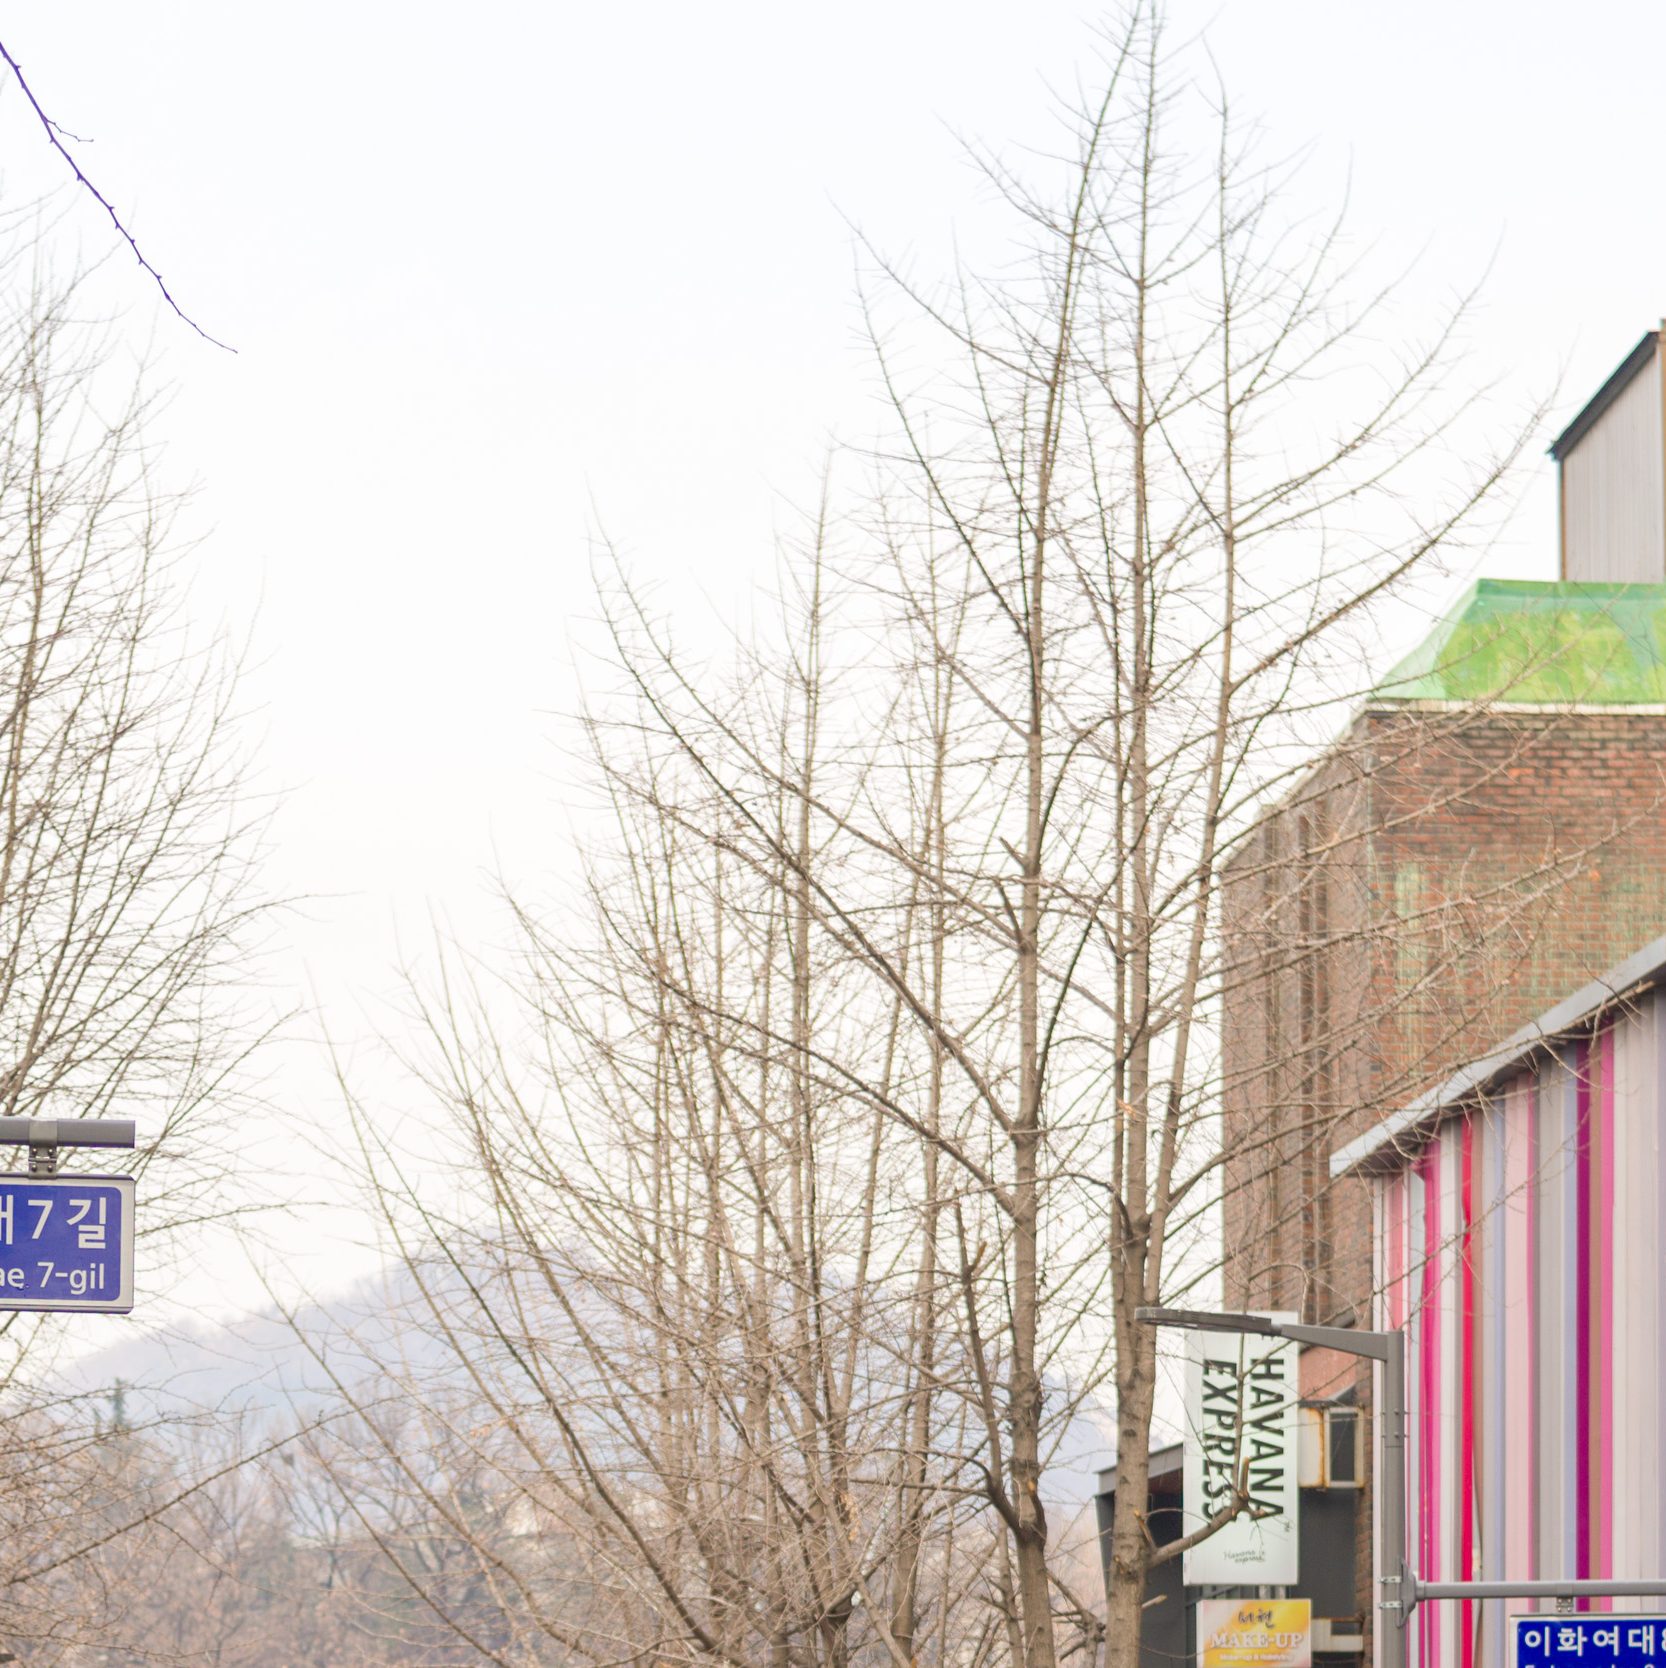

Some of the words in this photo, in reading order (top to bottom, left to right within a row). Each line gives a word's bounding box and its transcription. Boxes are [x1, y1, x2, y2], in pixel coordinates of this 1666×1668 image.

[36, 1261, 106, 1294] 7-gil
[1201, 1357, 1238, 1524] EXPRESS
[1249, 1357, 1286, 1523] HAVANA
[1209, 1632, 1303, 1650] MAKE-UP
